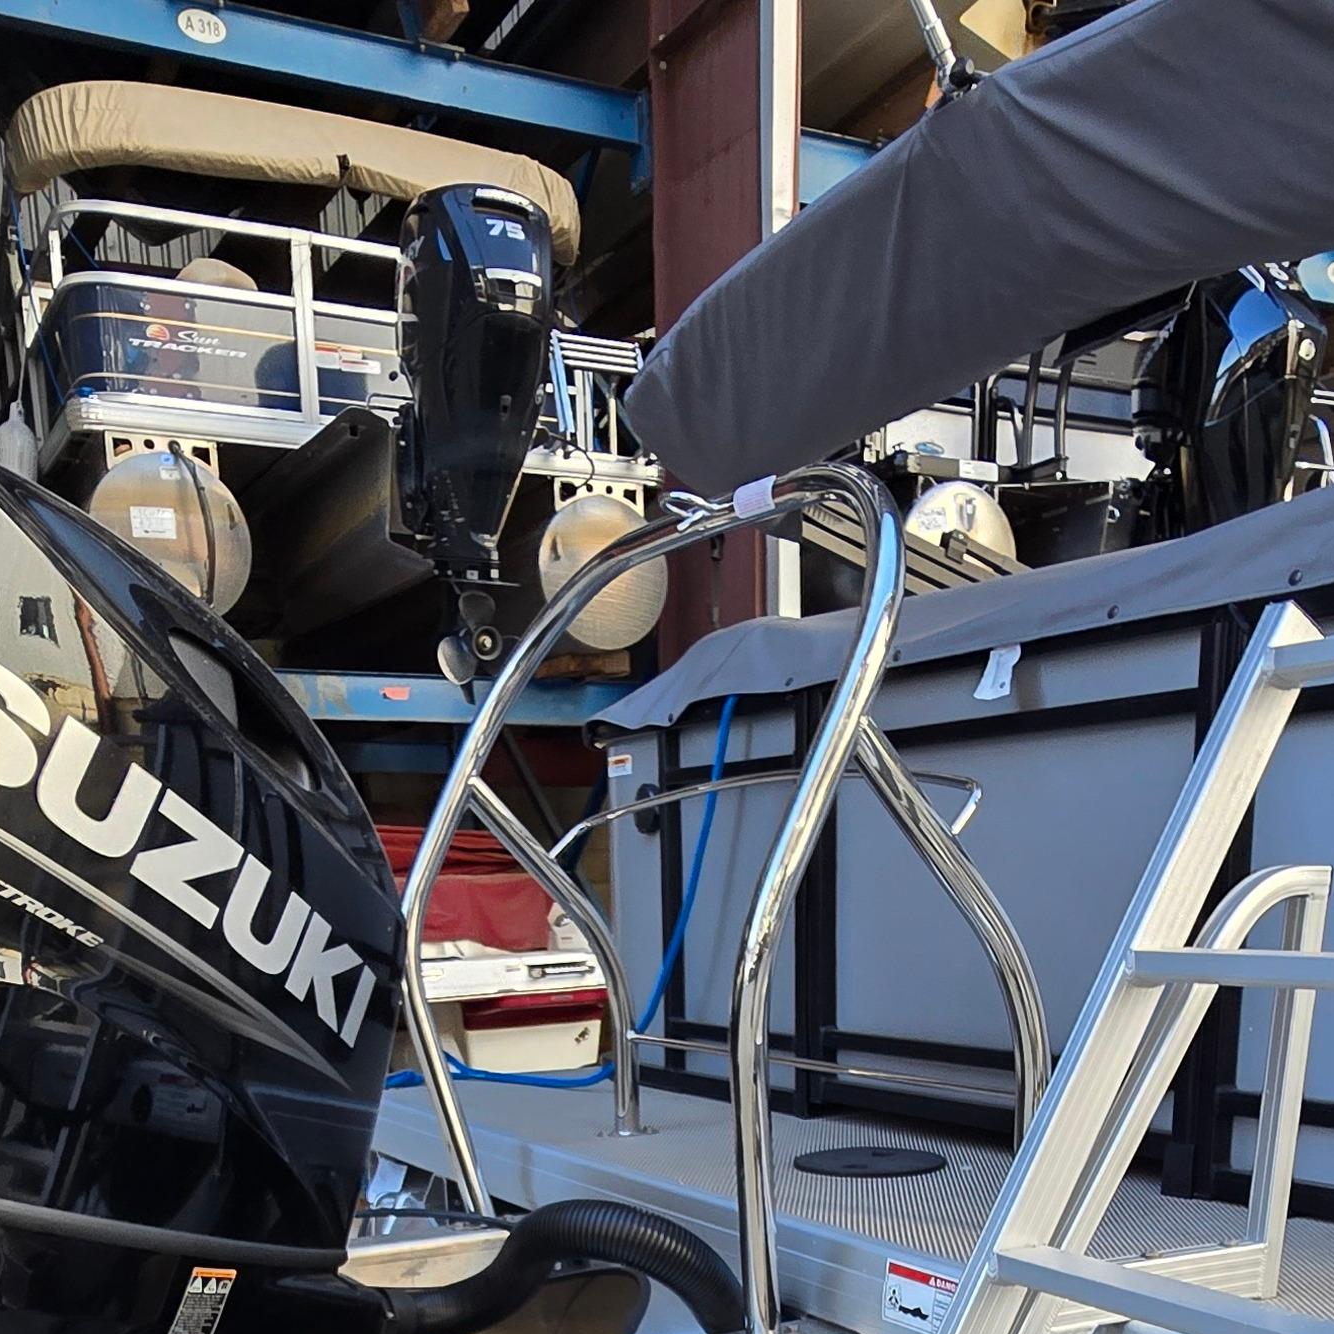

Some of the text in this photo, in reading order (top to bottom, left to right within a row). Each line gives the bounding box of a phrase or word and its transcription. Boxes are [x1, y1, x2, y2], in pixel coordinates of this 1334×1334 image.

[185, 16, 220, 37] A 318
[485, 218, 526, 240] 75
[128, 337, 247, 359] TRACKER
